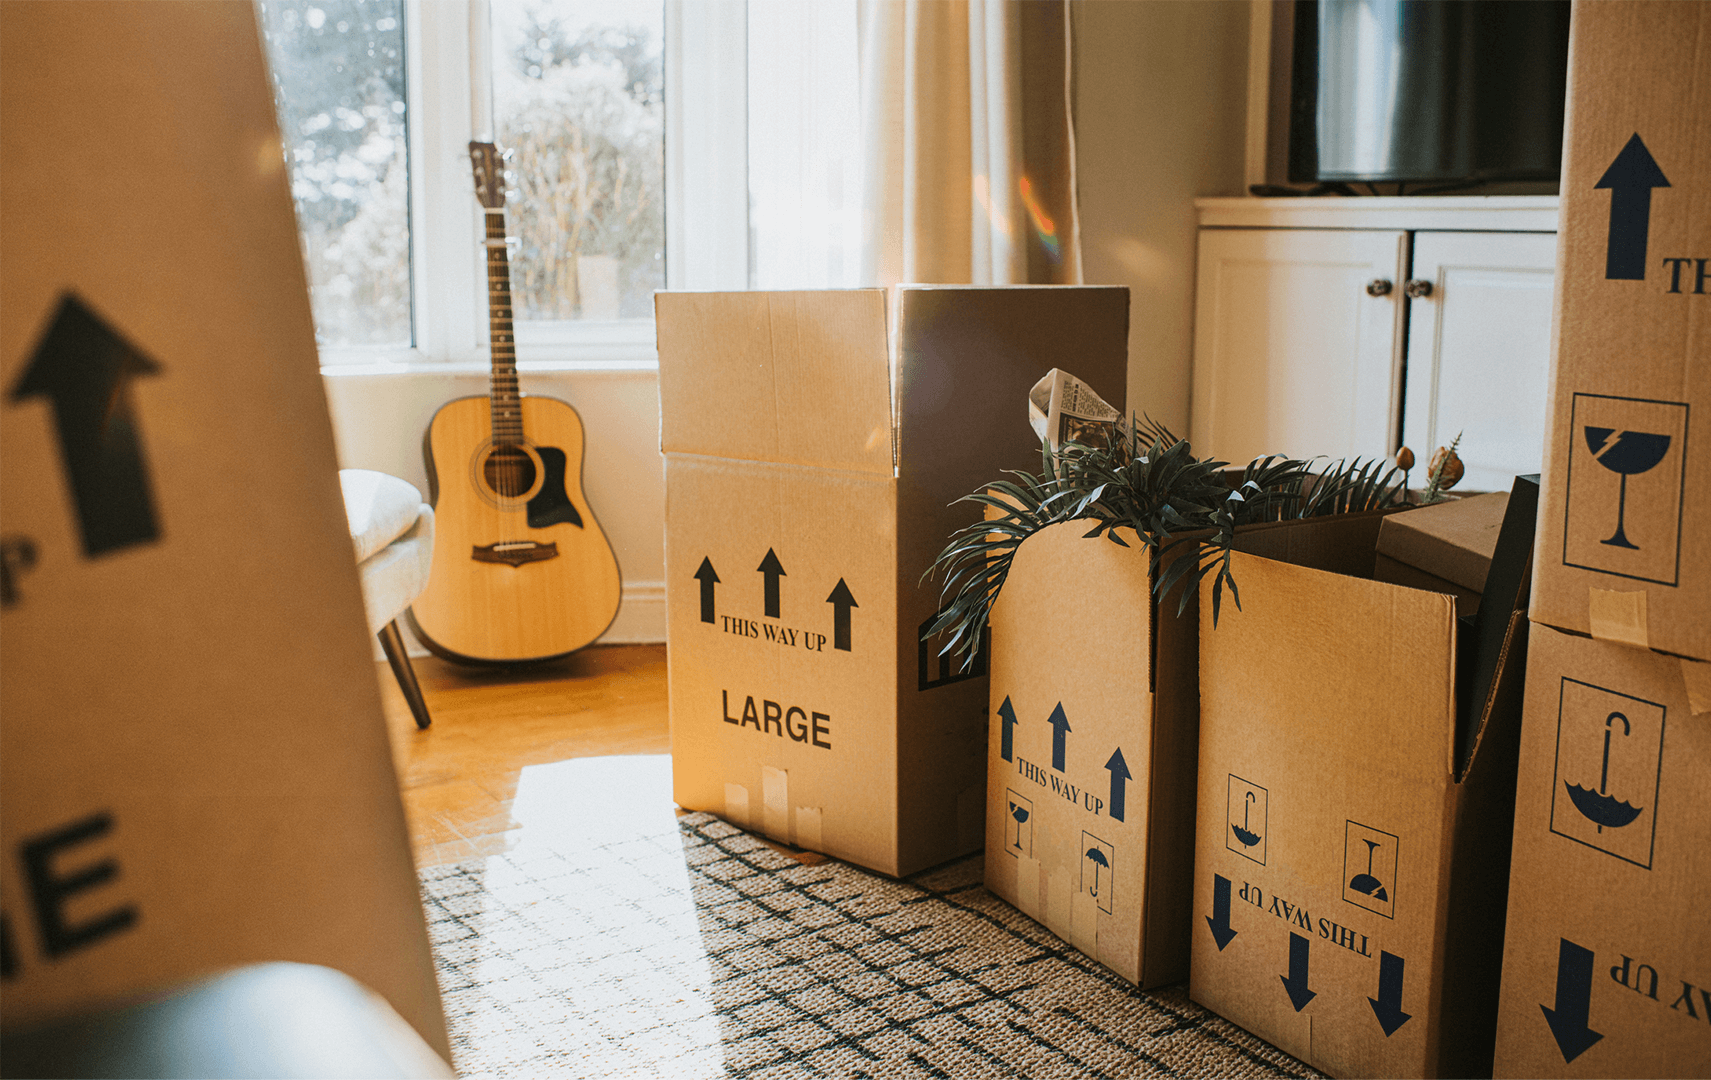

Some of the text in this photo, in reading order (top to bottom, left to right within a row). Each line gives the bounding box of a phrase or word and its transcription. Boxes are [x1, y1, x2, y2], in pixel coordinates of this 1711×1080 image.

[721, 615, 827, 652] THIS WAY UP
[721, 689, 832, 750] LARGE
[1017, 756, 1104, 817] THIS WAY UP
[0, 808, 141, 980] E
[1239, 881, 1372, 959] THIS WAY UP
[1609, 953, 1661, 1002] UP
